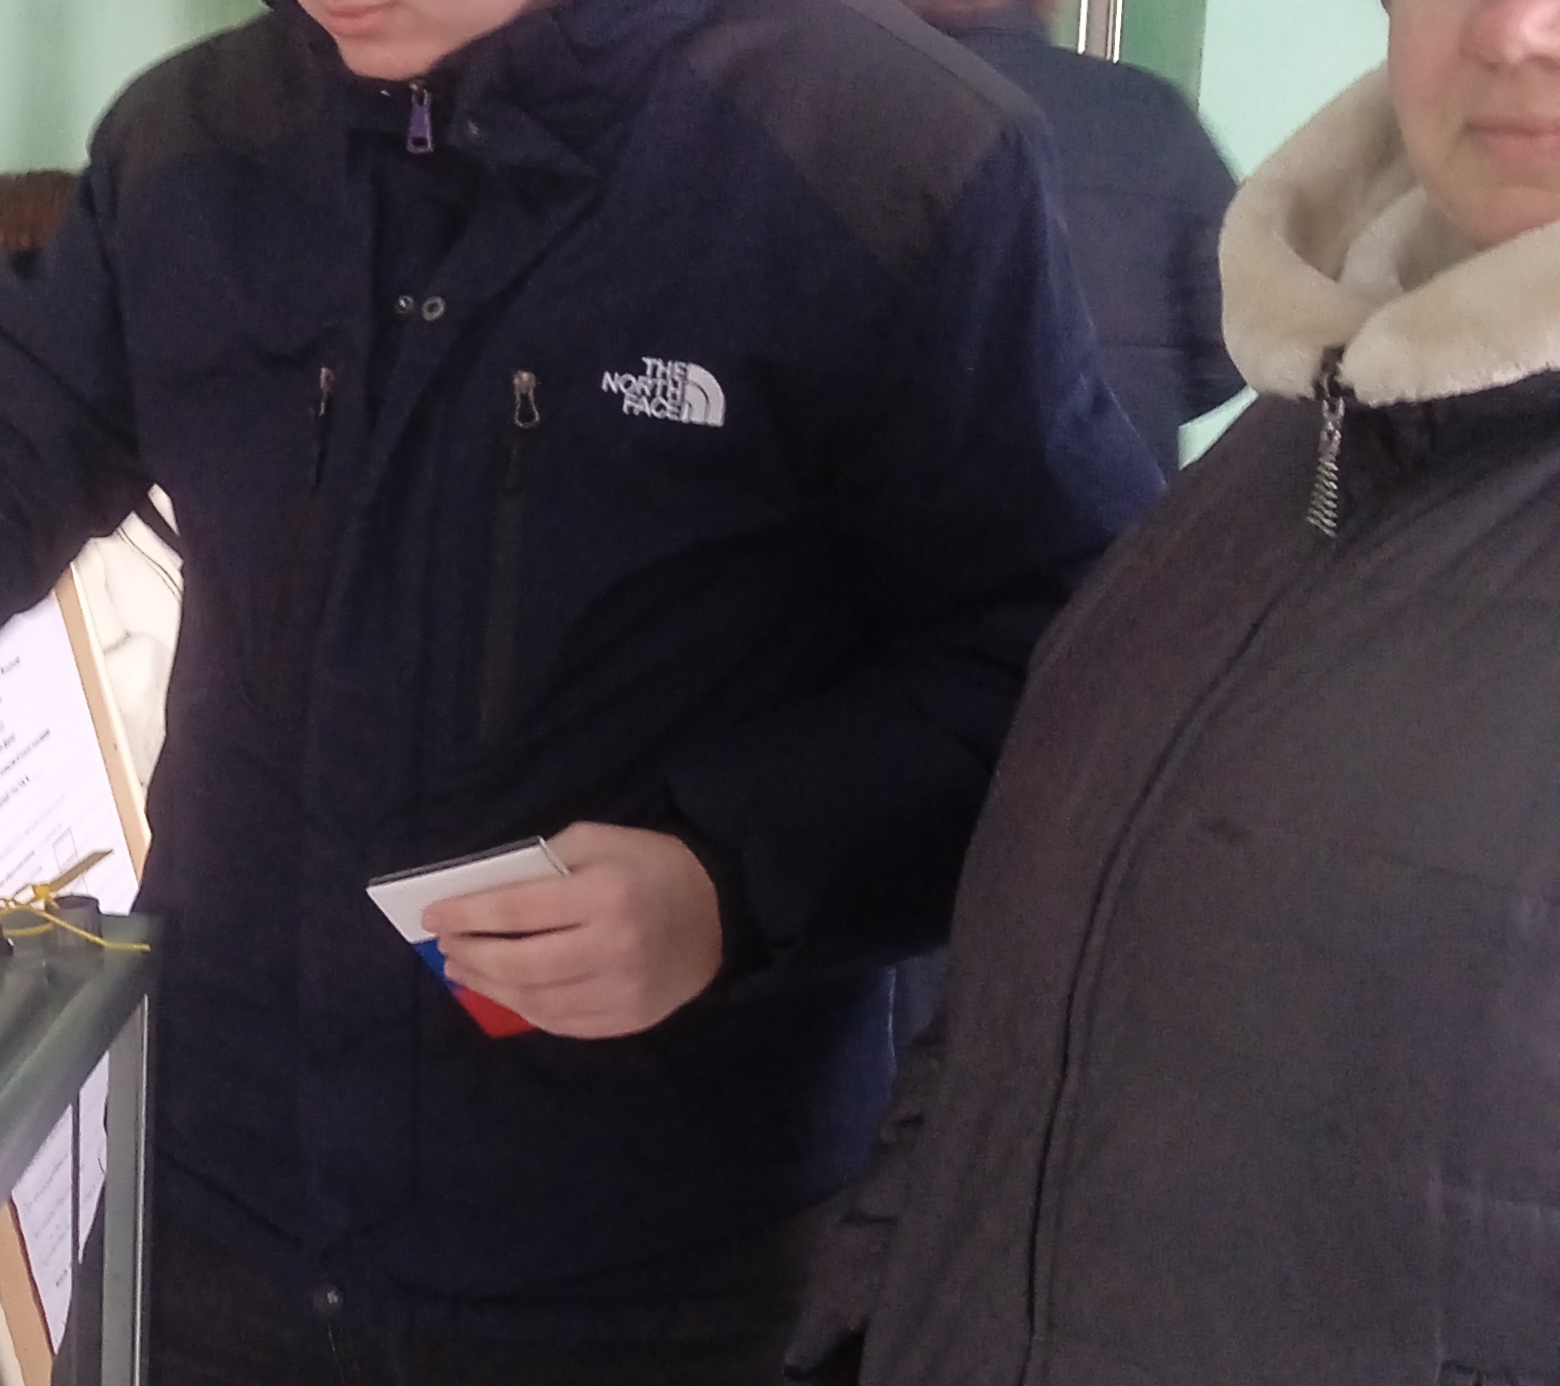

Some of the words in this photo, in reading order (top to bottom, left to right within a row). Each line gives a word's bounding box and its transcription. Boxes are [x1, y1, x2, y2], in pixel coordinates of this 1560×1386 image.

[642, 356, 687, 380] THE
[601, 370, 684, 402] NORTH
[622, 392, 681, 421] FACE
